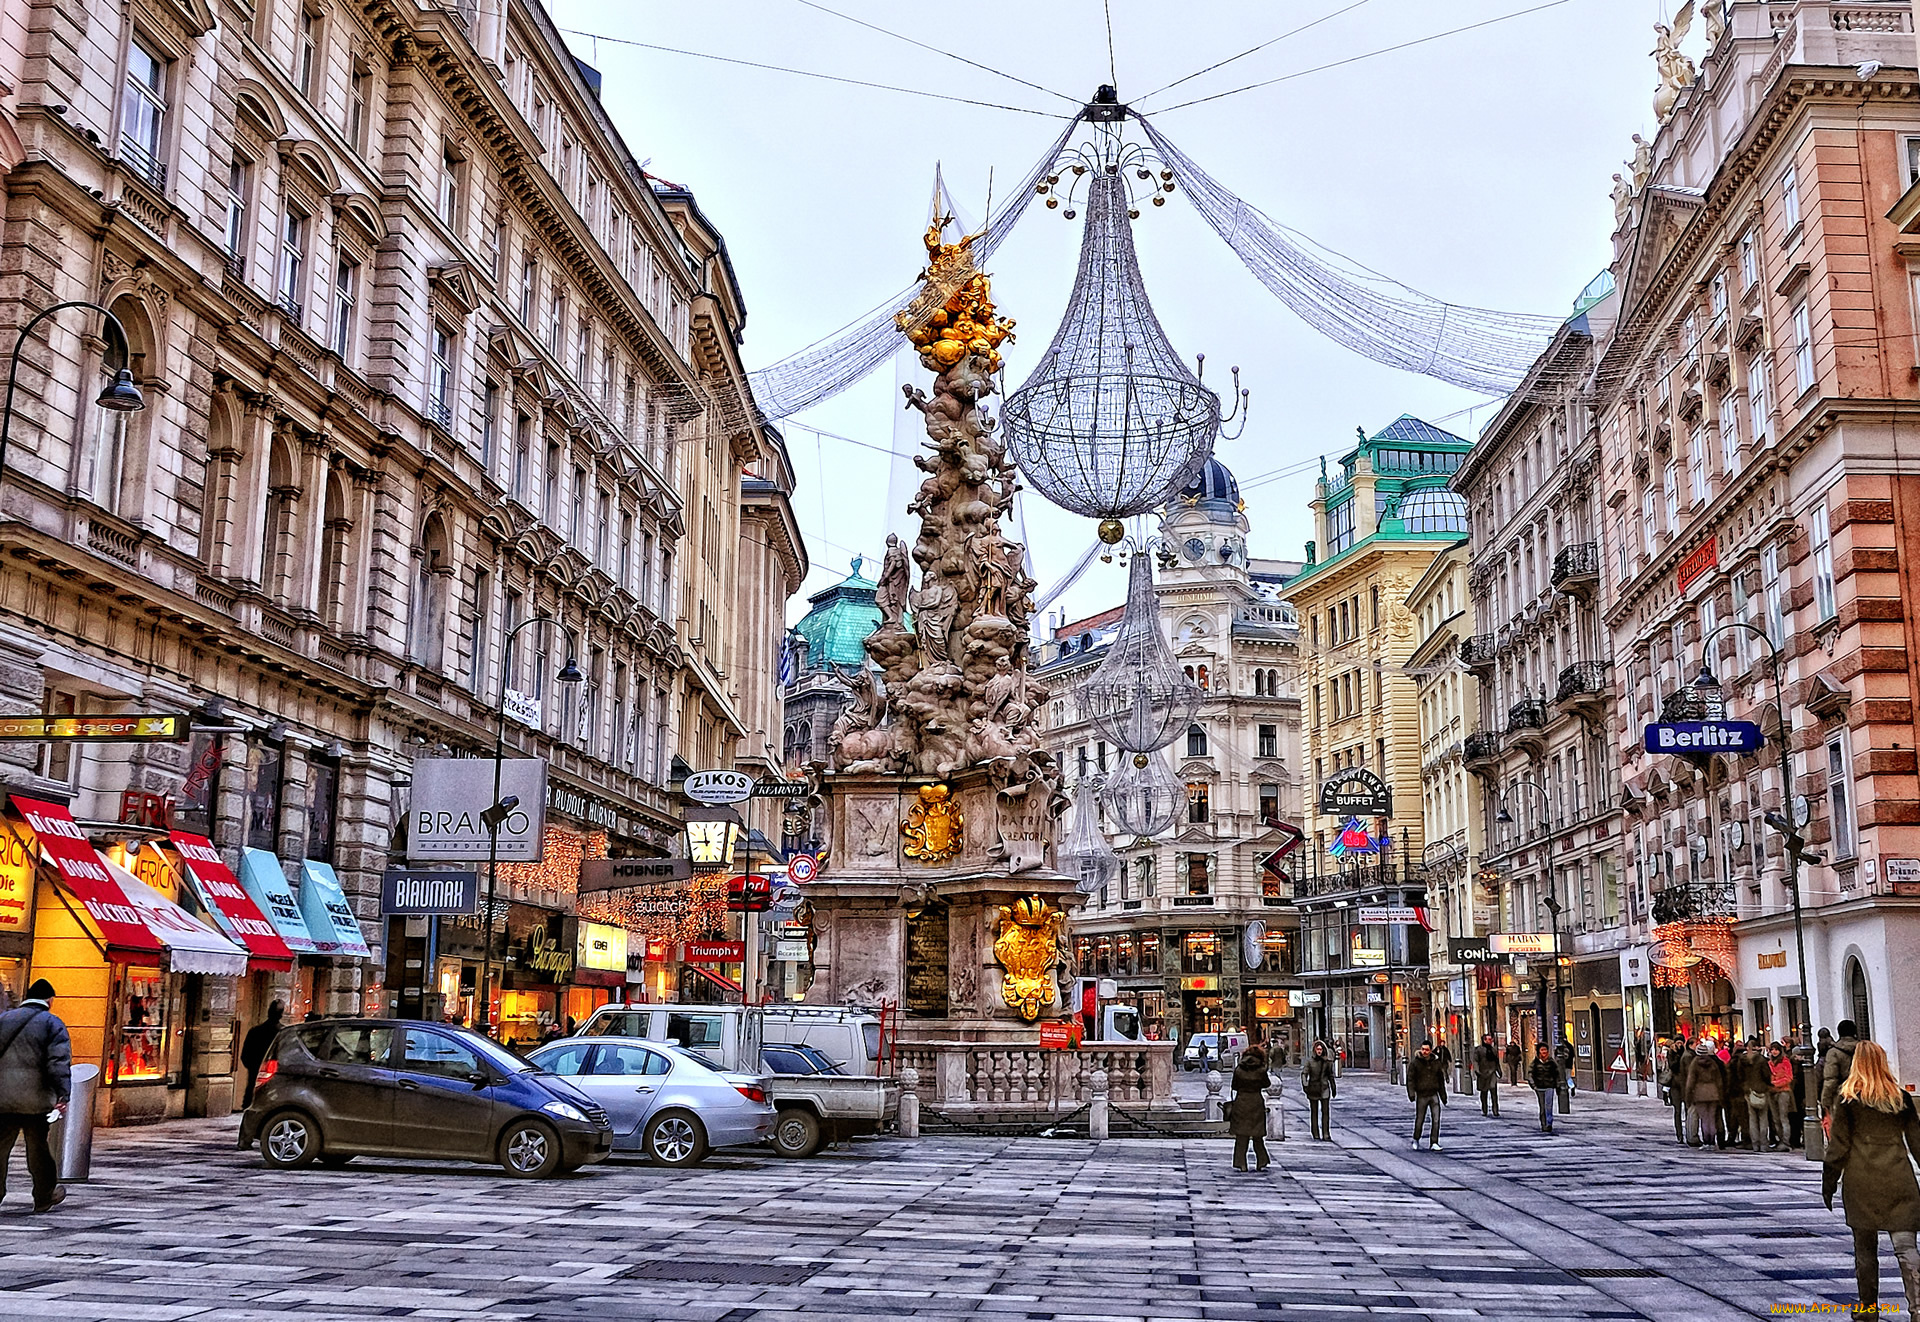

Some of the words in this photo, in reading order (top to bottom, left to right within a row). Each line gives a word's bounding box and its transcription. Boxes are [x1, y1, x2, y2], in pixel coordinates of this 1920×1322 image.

[1658, 725, 1744, 747] Berlitz
[692, 772, 748, 789] ZIKOS
[1336, 796, 1375, 806] BUFFET
[588, 798, 618, 829] HÜBNER
[1002, 814, 1041, 826] PATRI
[58, 857, 110, 882] BOOKS
[612, 864, 675, 878] HÜBNER
[204, 880, 246, 900] BOOKS
[633, 900, 690, 913] swatch
[1508, 935, 1542, 944] HABAN
[690, 945, 731, 958] Triumph
